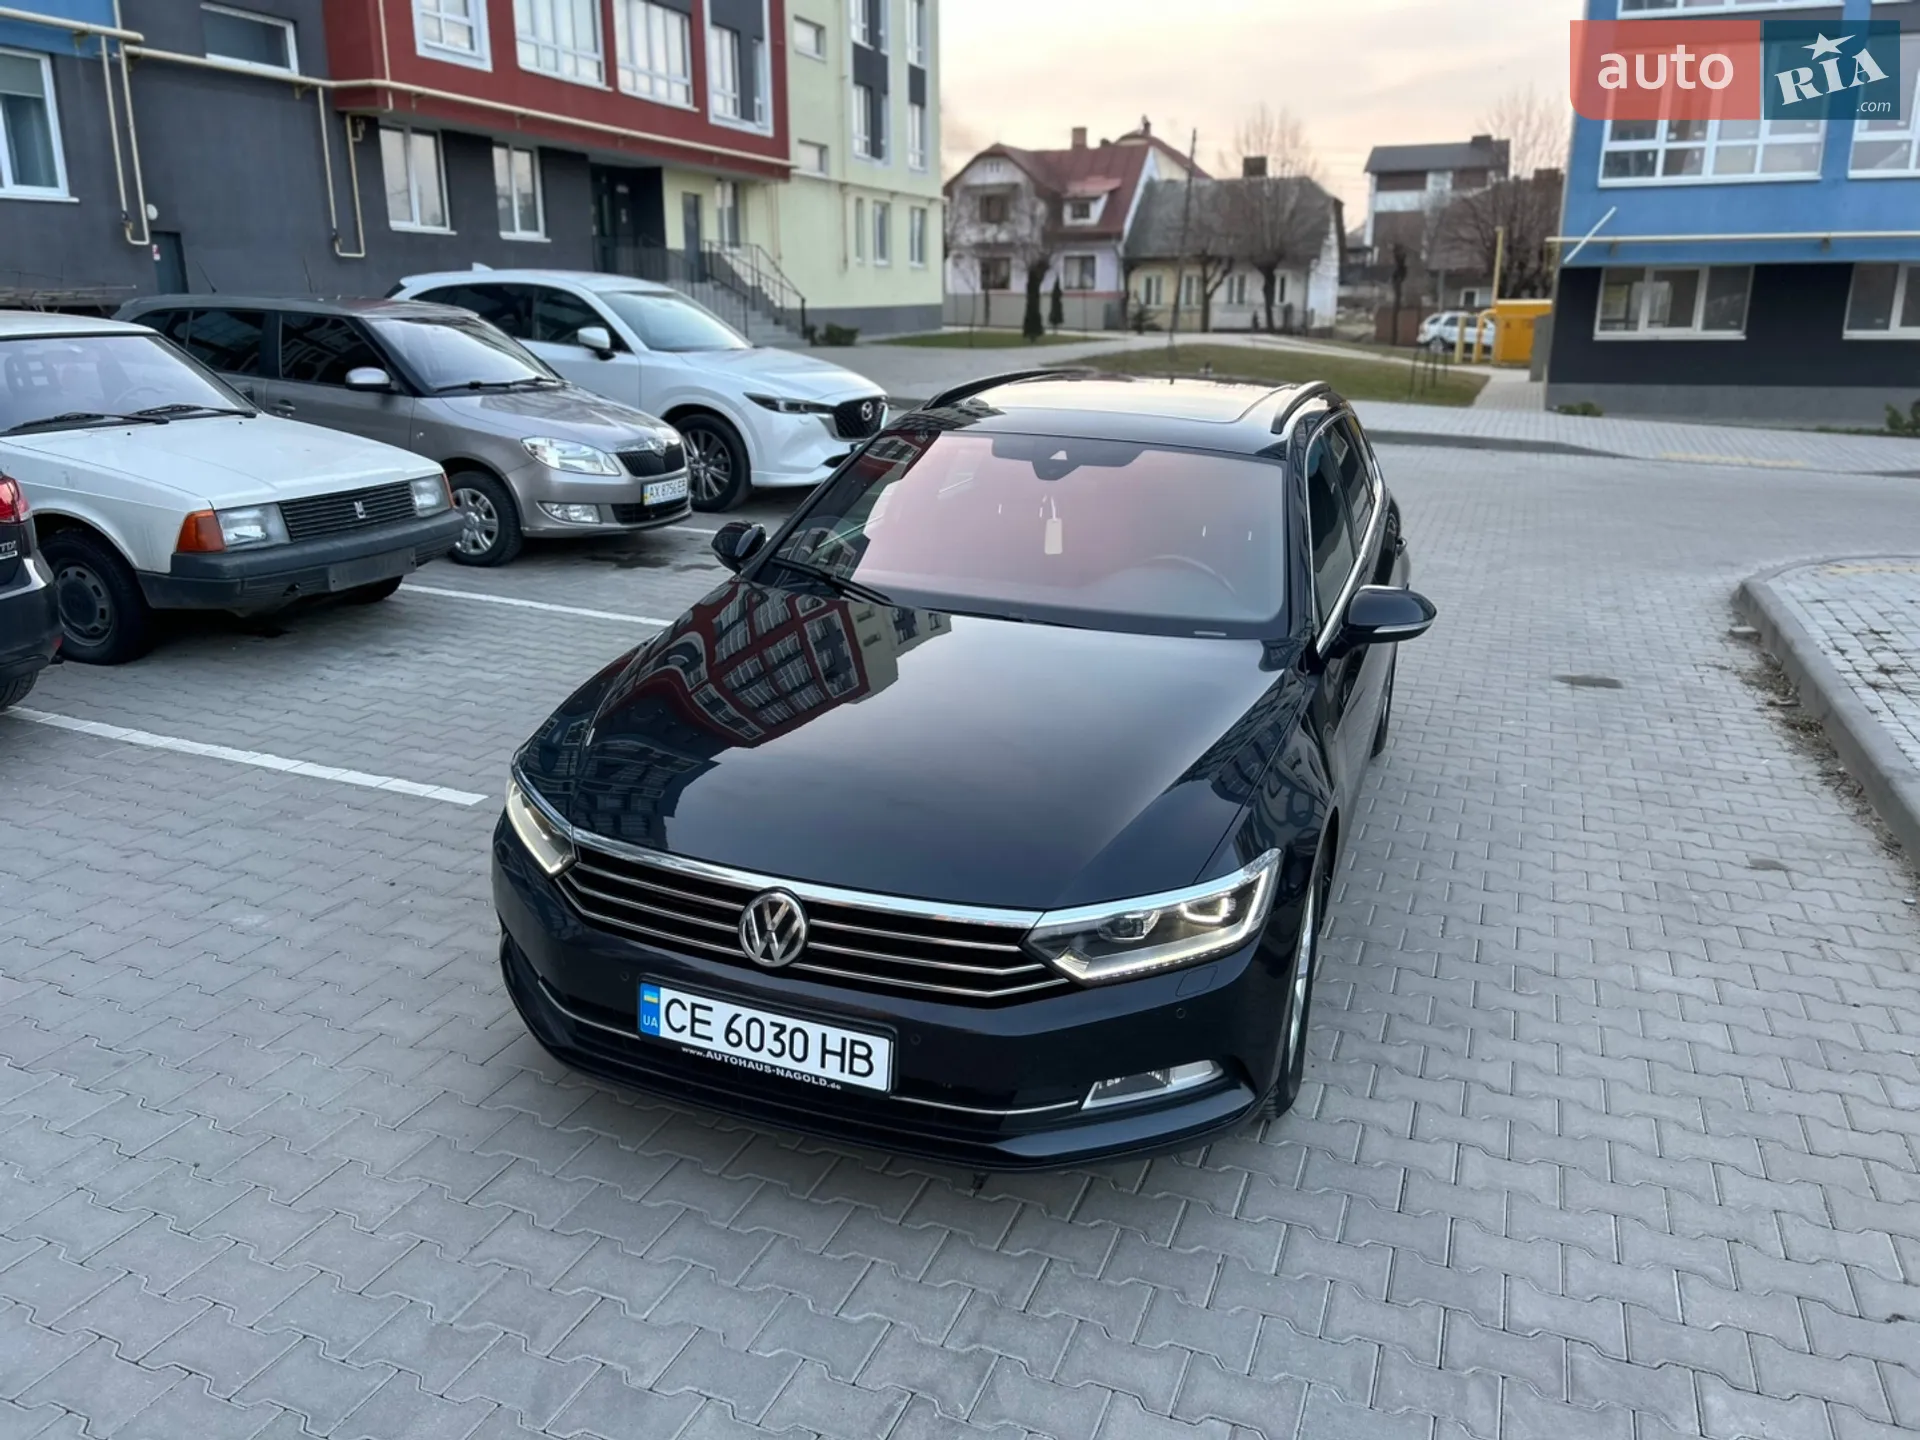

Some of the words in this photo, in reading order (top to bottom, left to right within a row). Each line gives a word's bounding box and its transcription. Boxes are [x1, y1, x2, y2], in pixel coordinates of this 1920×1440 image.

[643, 1014, 658, 1027] UA
[664, 998, 714, 1042] CE
[724, 1013, 810, 1063] 6030
[820, 1033, 875, 1078] HB
[681, 1046, 842, 1090] www.AUTOHAUS-NAGOLD.de
